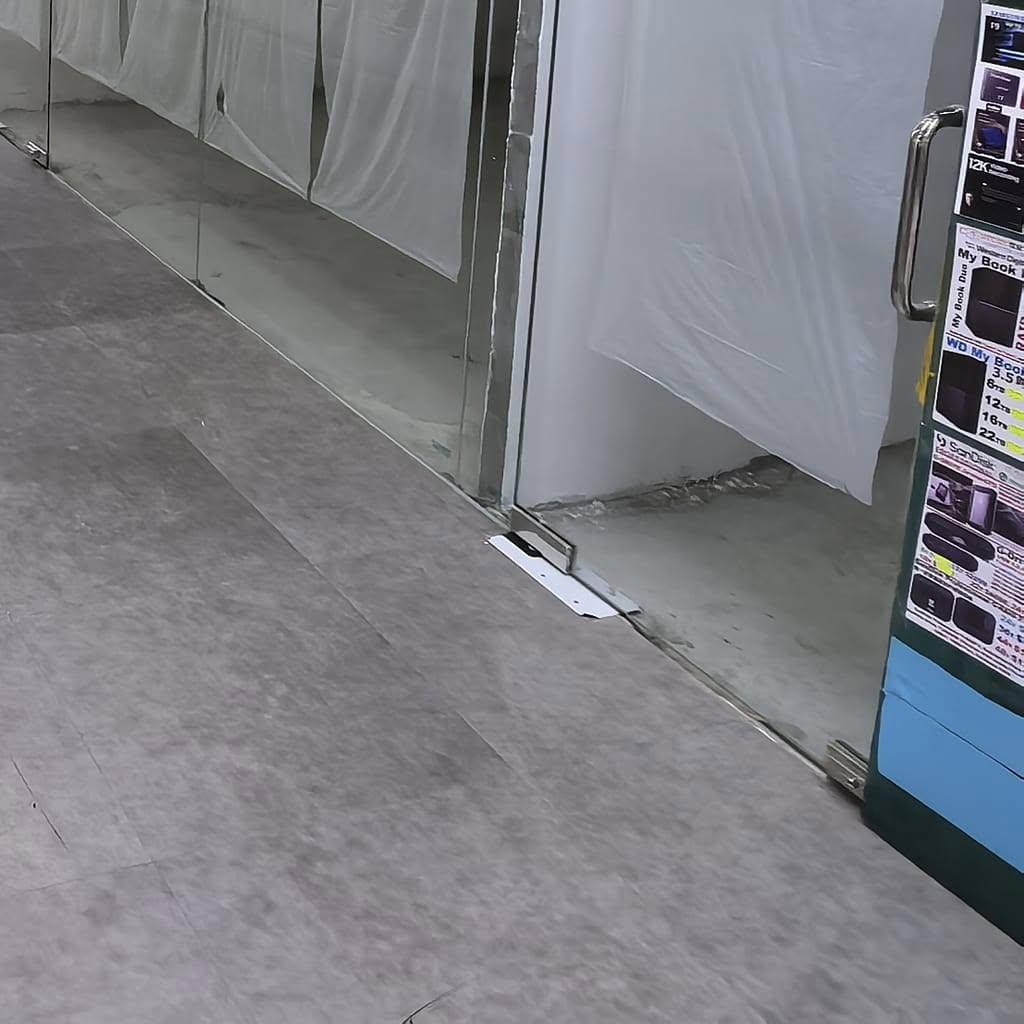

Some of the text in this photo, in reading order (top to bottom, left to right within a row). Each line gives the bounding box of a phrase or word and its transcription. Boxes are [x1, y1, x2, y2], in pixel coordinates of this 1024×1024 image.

[958, 248, 976, 263] My
[982, 255, 1016, 276] Book
[946, 337, 967, 352] WD
[971, 347, 990, 363] My
